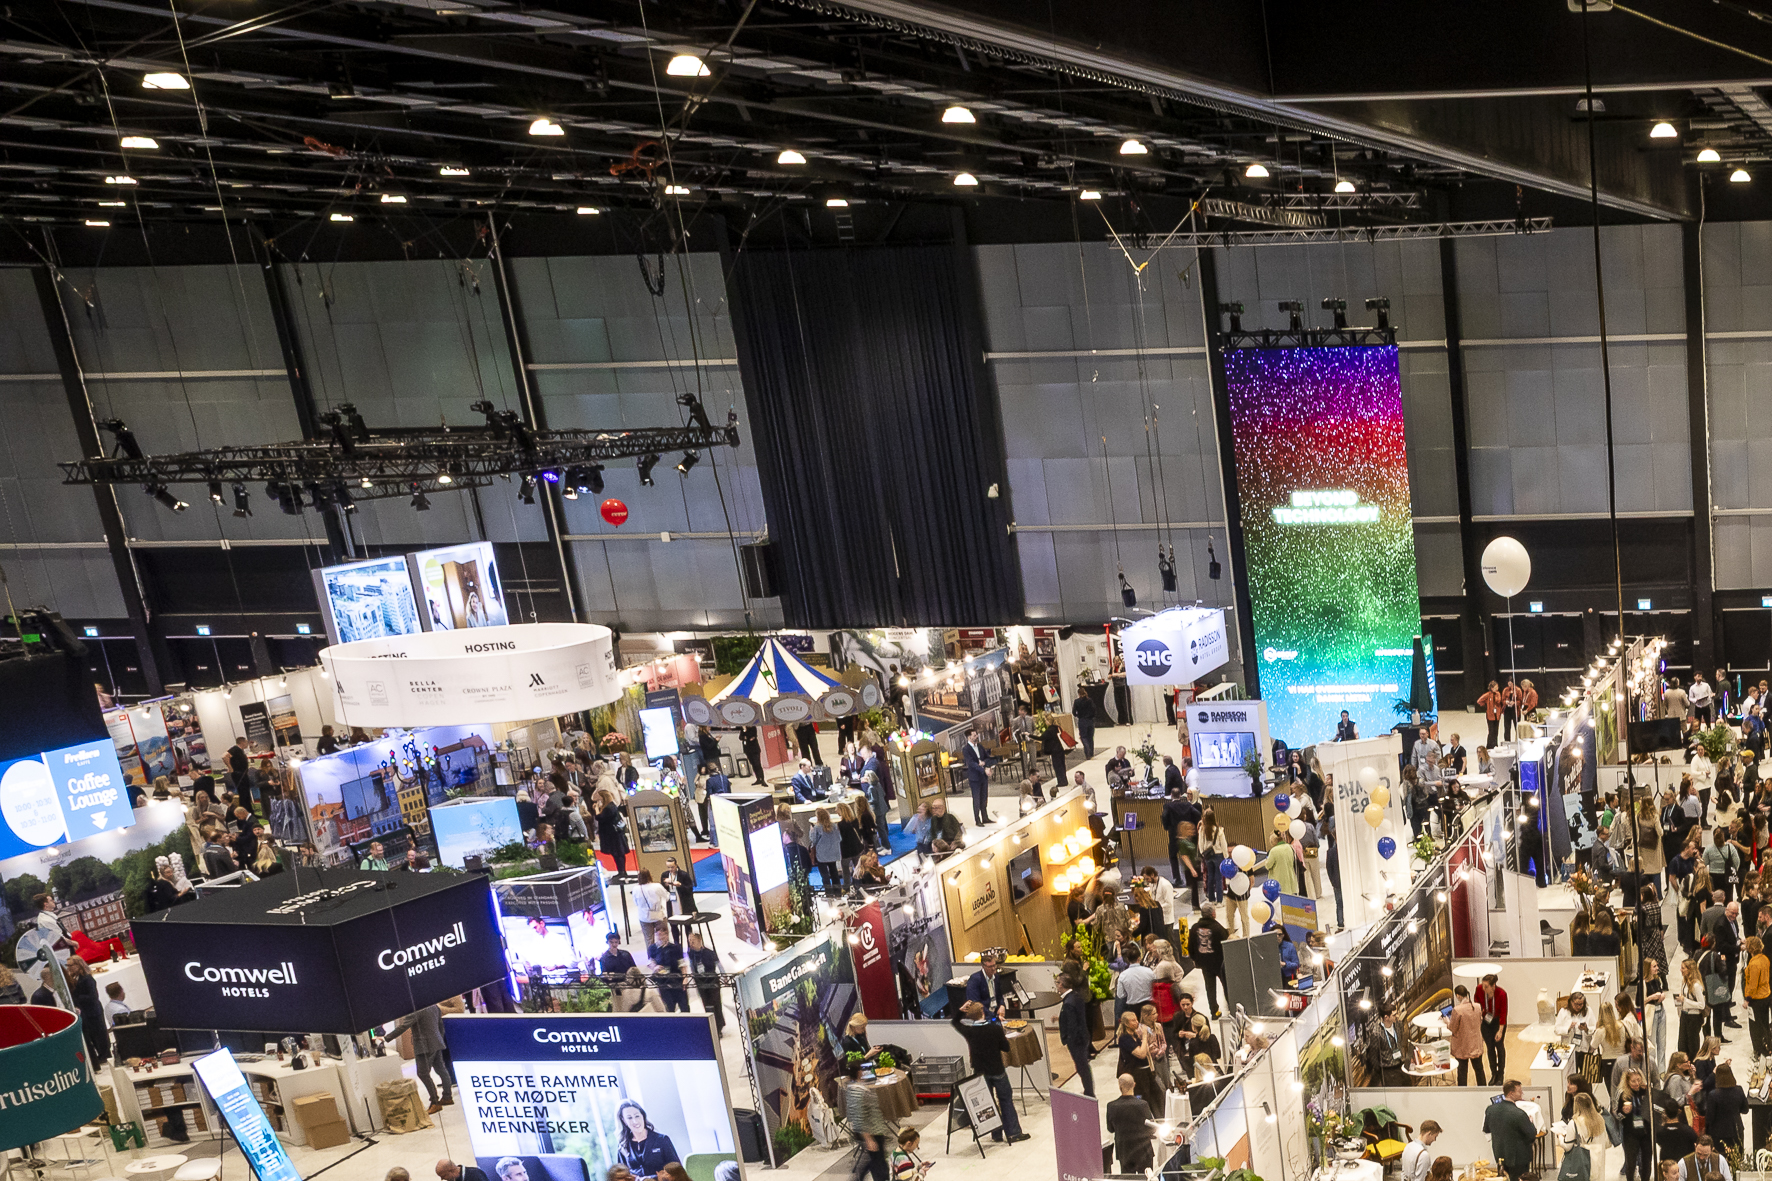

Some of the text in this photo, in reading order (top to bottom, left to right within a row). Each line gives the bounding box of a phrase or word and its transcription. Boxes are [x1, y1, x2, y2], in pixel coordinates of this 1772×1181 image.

[1291, 491, 1359, 507] BEYOND
[1273, 506, 1380, 523] TECHNOLOGY
[465, 641, 516, 653] HOSTING
[1198, 629, 1221, 650] RADISSON
[1136, 650, 1173, 666] RHG
[67, 773, 110, 795] Coffee
[67, 788, 118, 811] Lounge
[377, 922, 467, 971] Comwell
[184, 961, 298, 985] Comwell
[407, 955, 446, 977] HOTELS
[769, 951, 827, 993] BaneGaaen
[221, 986, 270, 998] HOTELS
[533, 1026, 621, 1044] Comwell
[561, 1045, 599, 1053] HOTELS
[0, 1066, 80, 1111] ruiseline
[471, 1075, 619, 1088] BEDSTE RAMMER
[475, 1090, 577, 1103] FOR MØDET
[478, 1106, 549, 1118] MELLEM
[482, 1121, 590, 1134] MENNESKER
